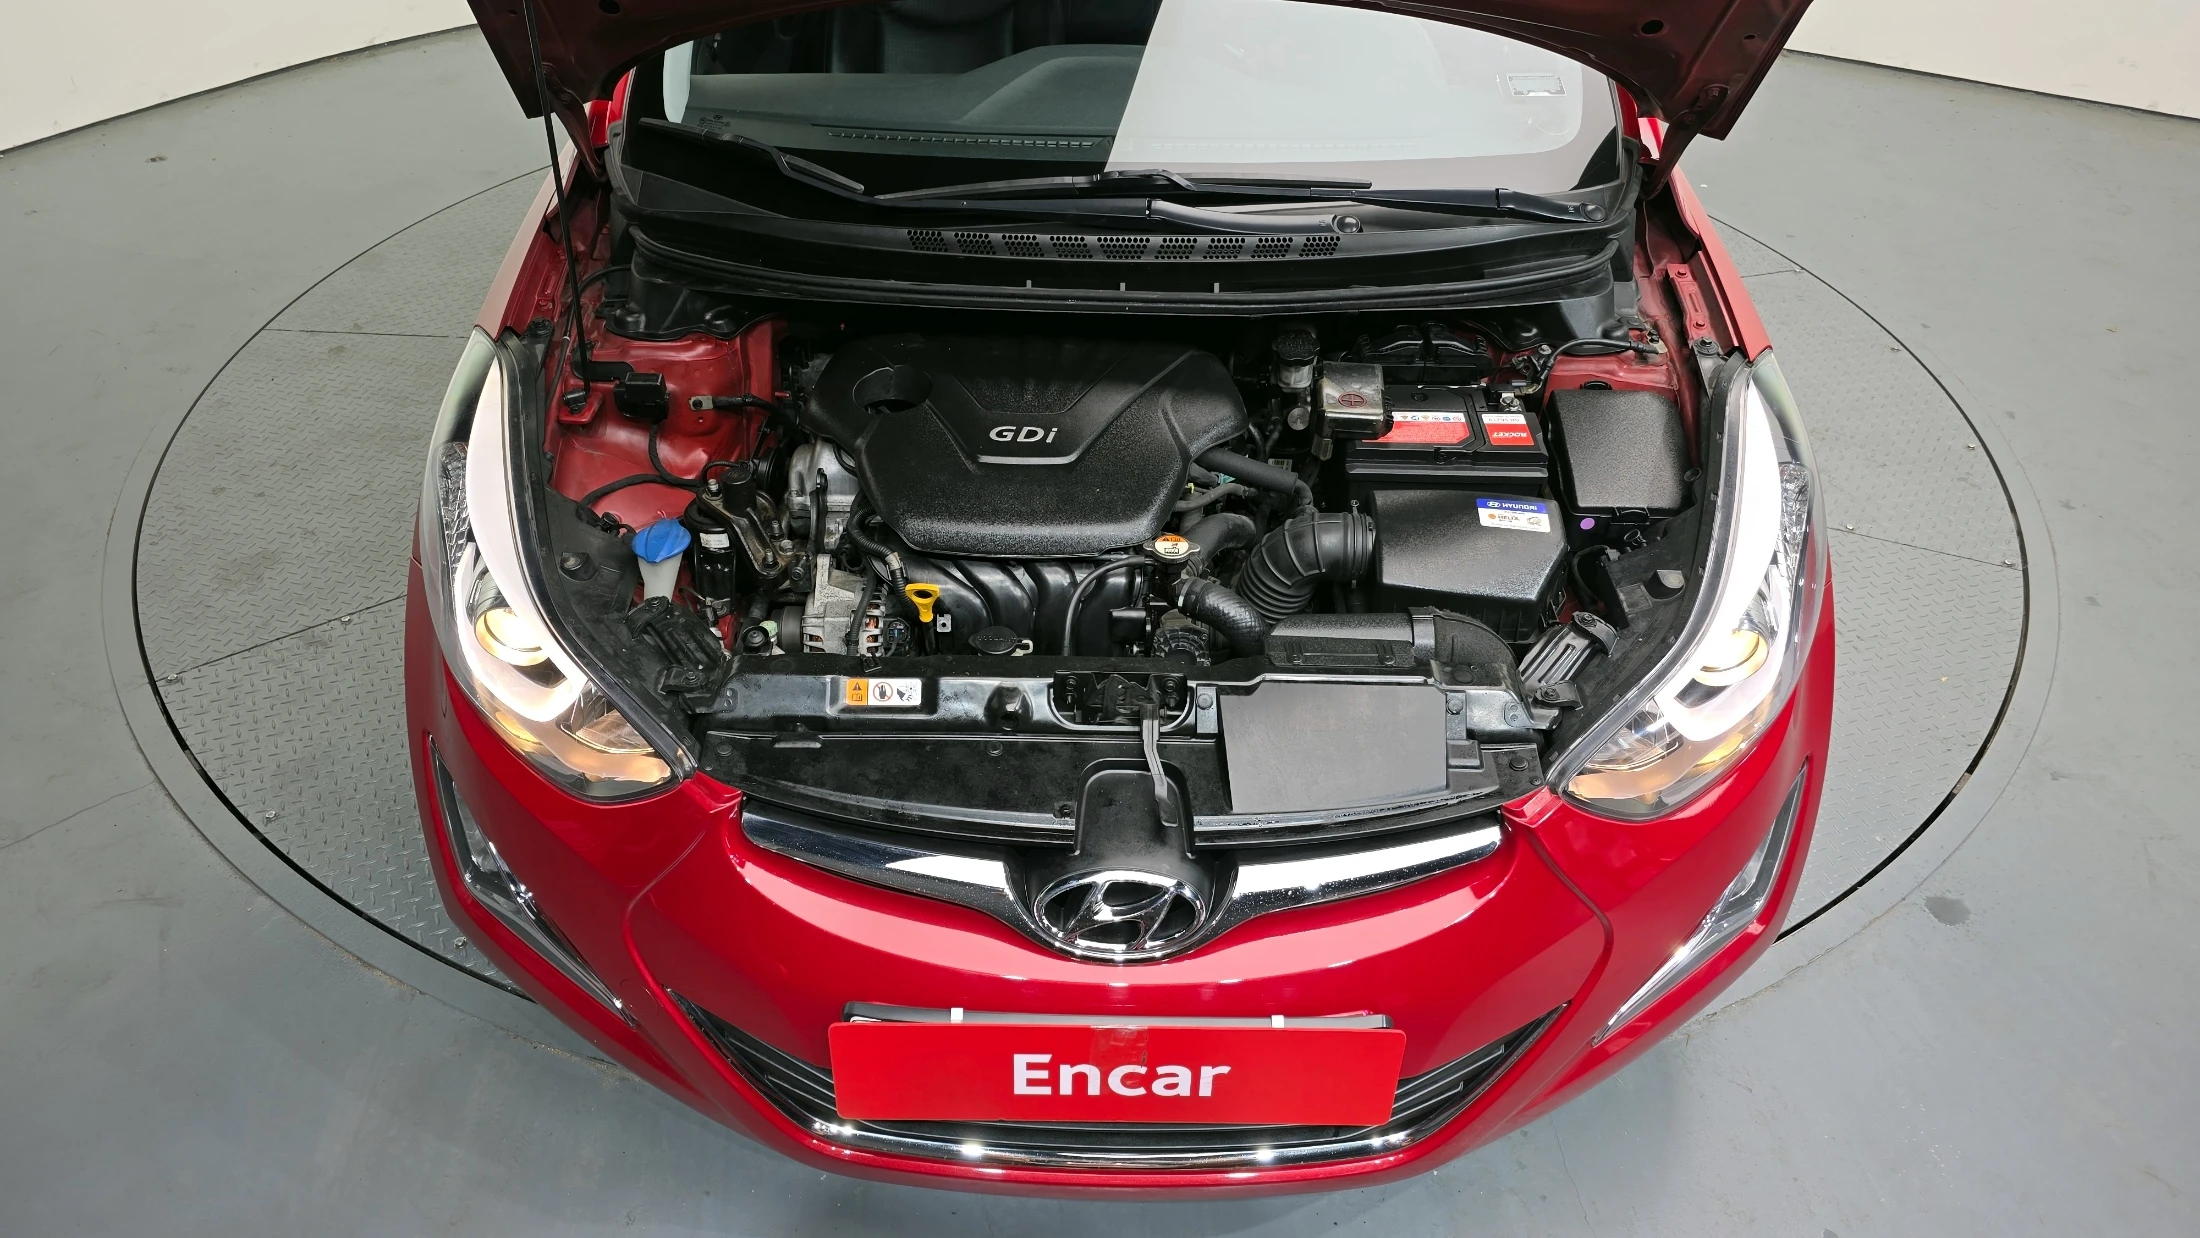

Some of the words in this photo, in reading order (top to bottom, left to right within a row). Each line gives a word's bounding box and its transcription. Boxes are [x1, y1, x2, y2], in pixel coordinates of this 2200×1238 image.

[989, 425, 1058, 443] GDi
[1502, 502, 1538, 511] HYUNDAI
[1013, 1053, 1232, 1097] Encar
